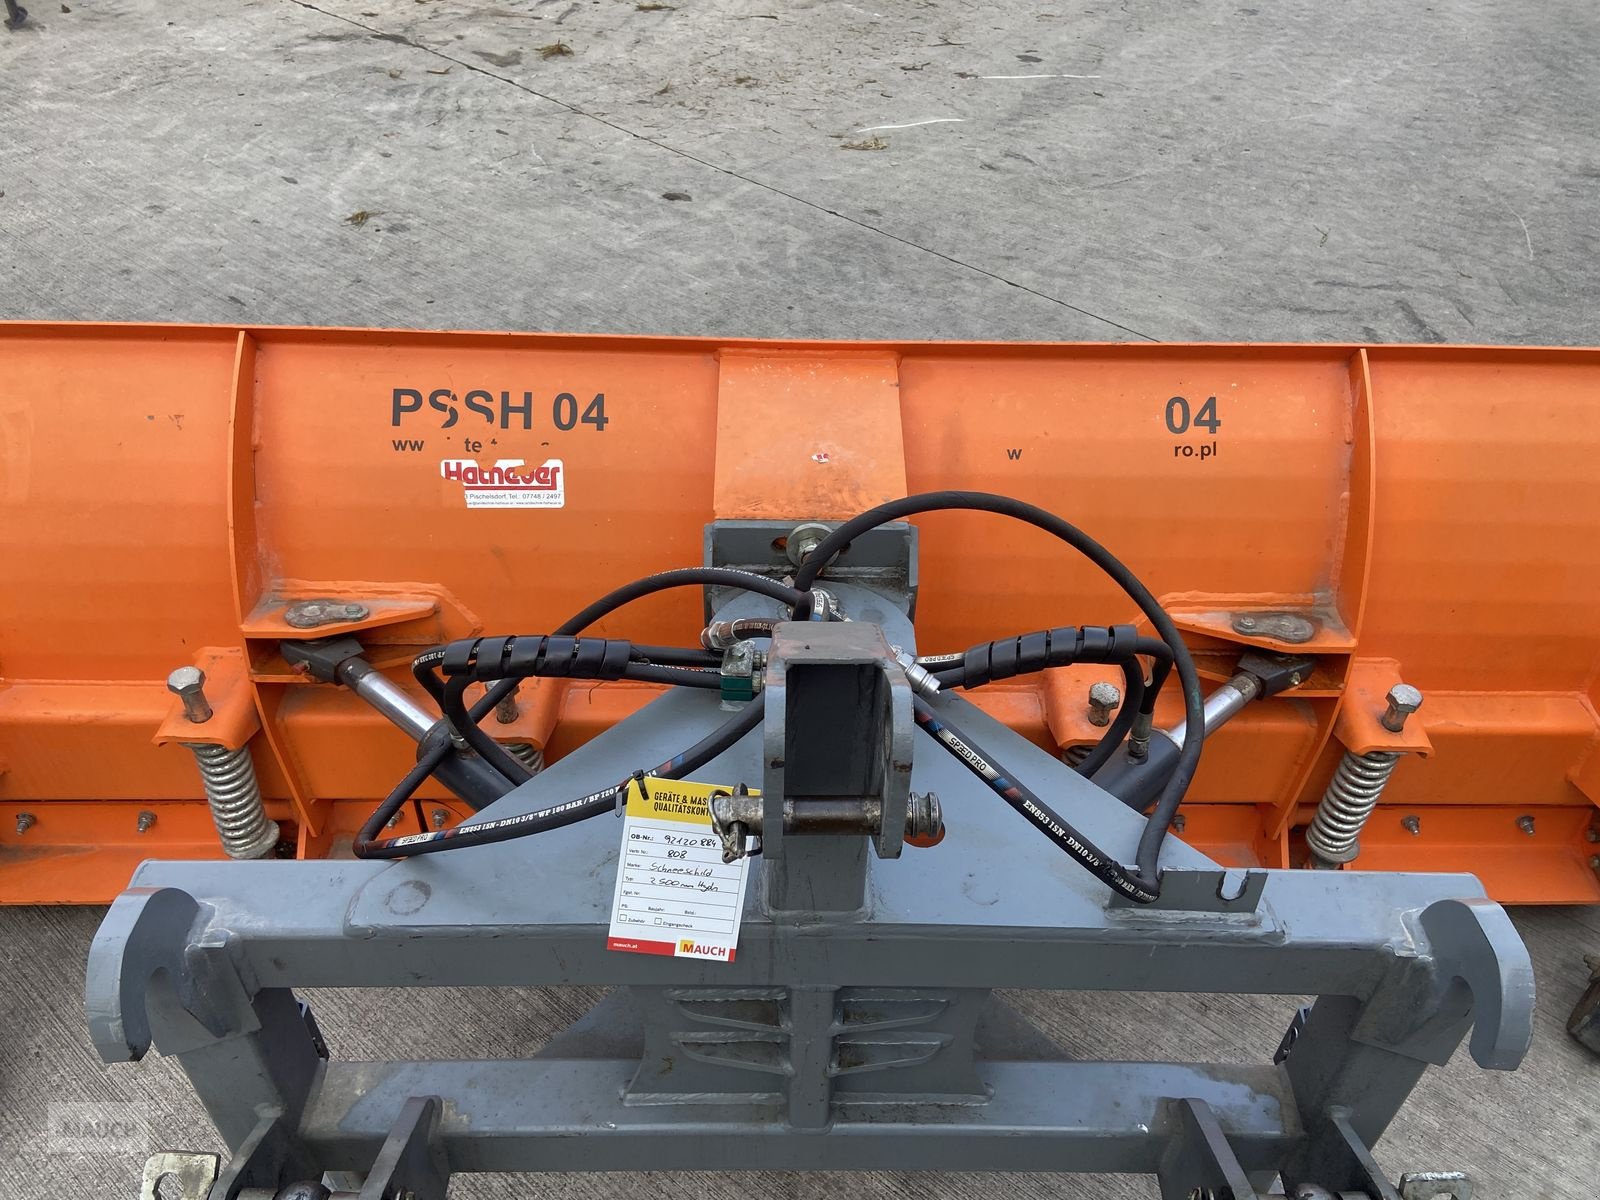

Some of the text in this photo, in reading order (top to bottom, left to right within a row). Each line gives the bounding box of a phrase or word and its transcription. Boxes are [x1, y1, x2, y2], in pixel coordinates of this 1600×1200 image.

[552, 392, 608, 431] 04
[1165, 396, 1222, 434] 04
[1174, 442, 1217, 460] ro.pl
[949, 738, 986, 770] SPEED PRO
[654, 792, 680, 803] GERÄTE
[500, 818, 520, 827] DN10
[538, 808, 552, 818] WP
[566, 800, 583, 810] BAR
[588, 794, 600, 802] BP
[1022, 800, 1050, 824] EN853
[1066, 836, 1088, 856] DN10
[668, 850, 688, 859] 808
[650, 862, 712, 877] Schneeschild
[683, 943, 726, 956] MAUCH
